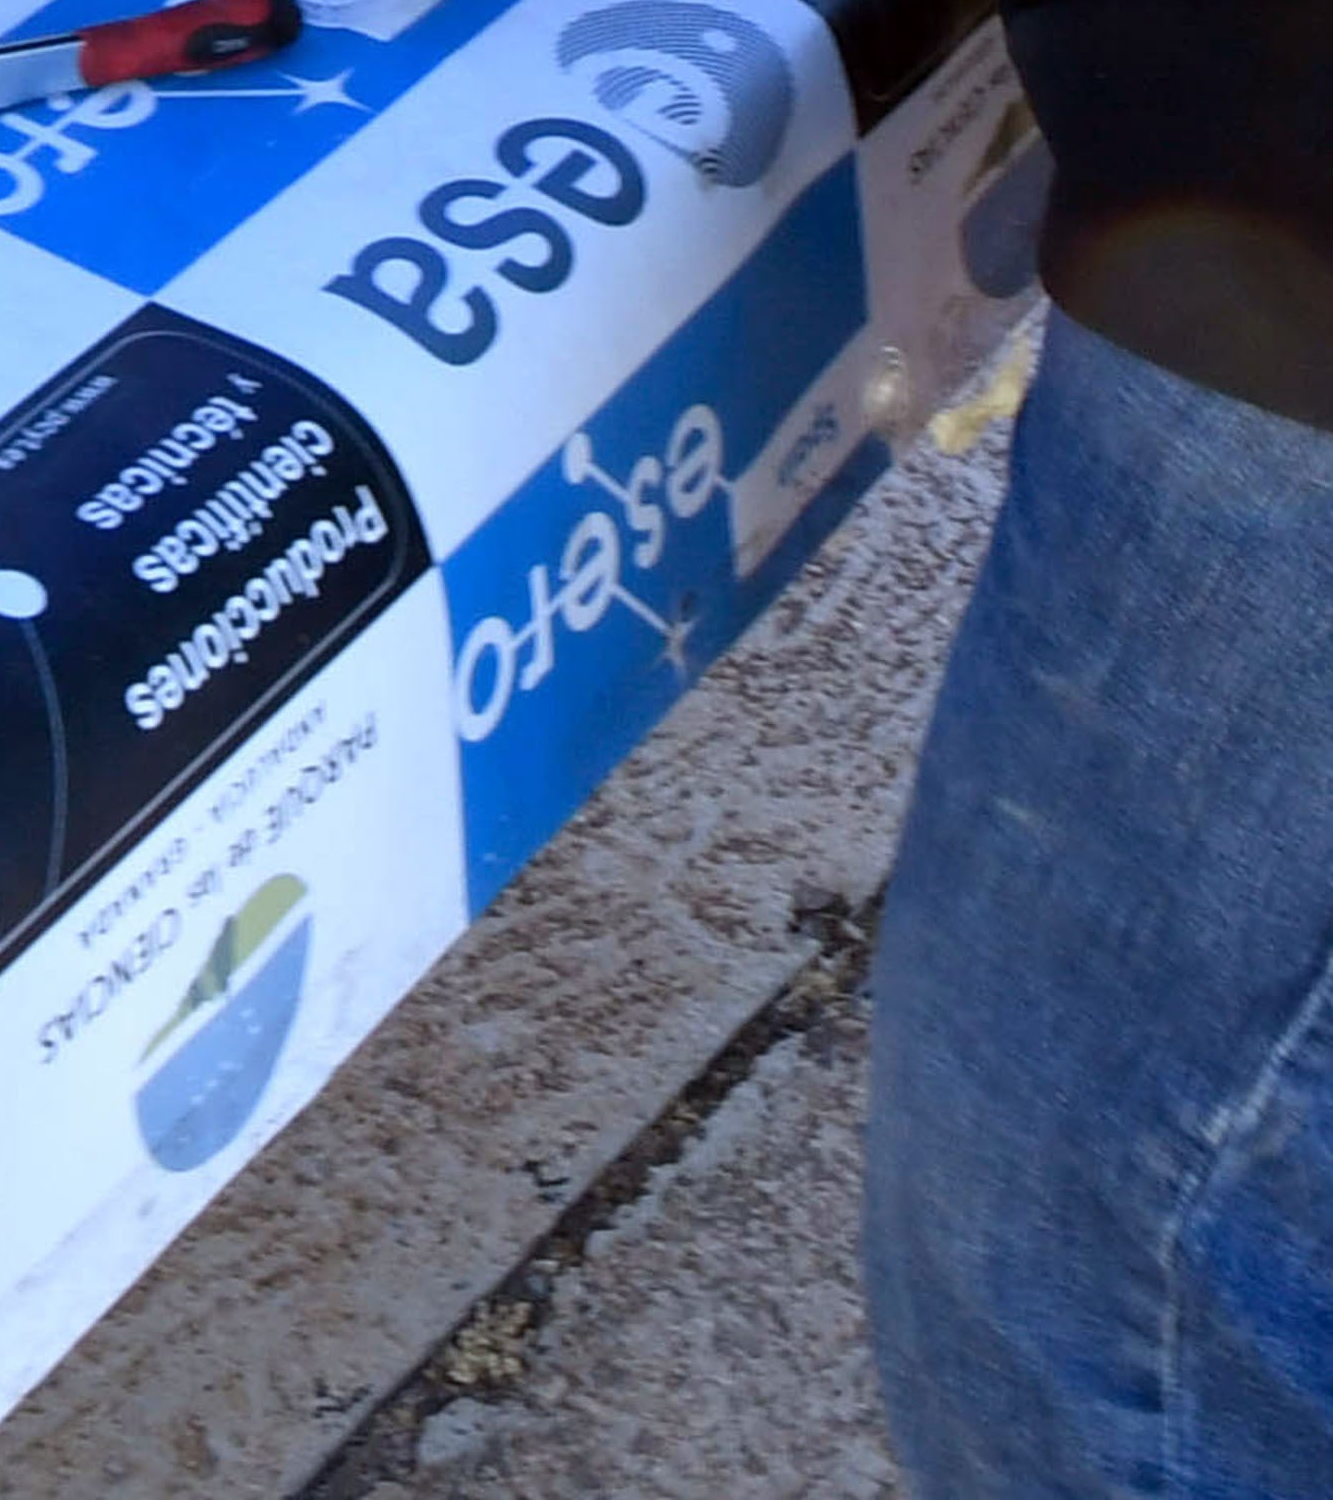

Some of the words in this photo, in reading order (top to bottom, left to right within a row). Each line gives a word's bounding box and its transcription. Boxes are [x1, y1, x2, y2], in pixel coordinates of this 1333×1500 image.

[321, 117, 646, 367] esa
[75, 395, 259, 530] técnicas
[124, 484, 389, 730] Producciones
[452, 403, 724, 742] esero
[265, 708, 378, 845] PARQUE
[37, 906, 182, 1066] CIENCIAS
